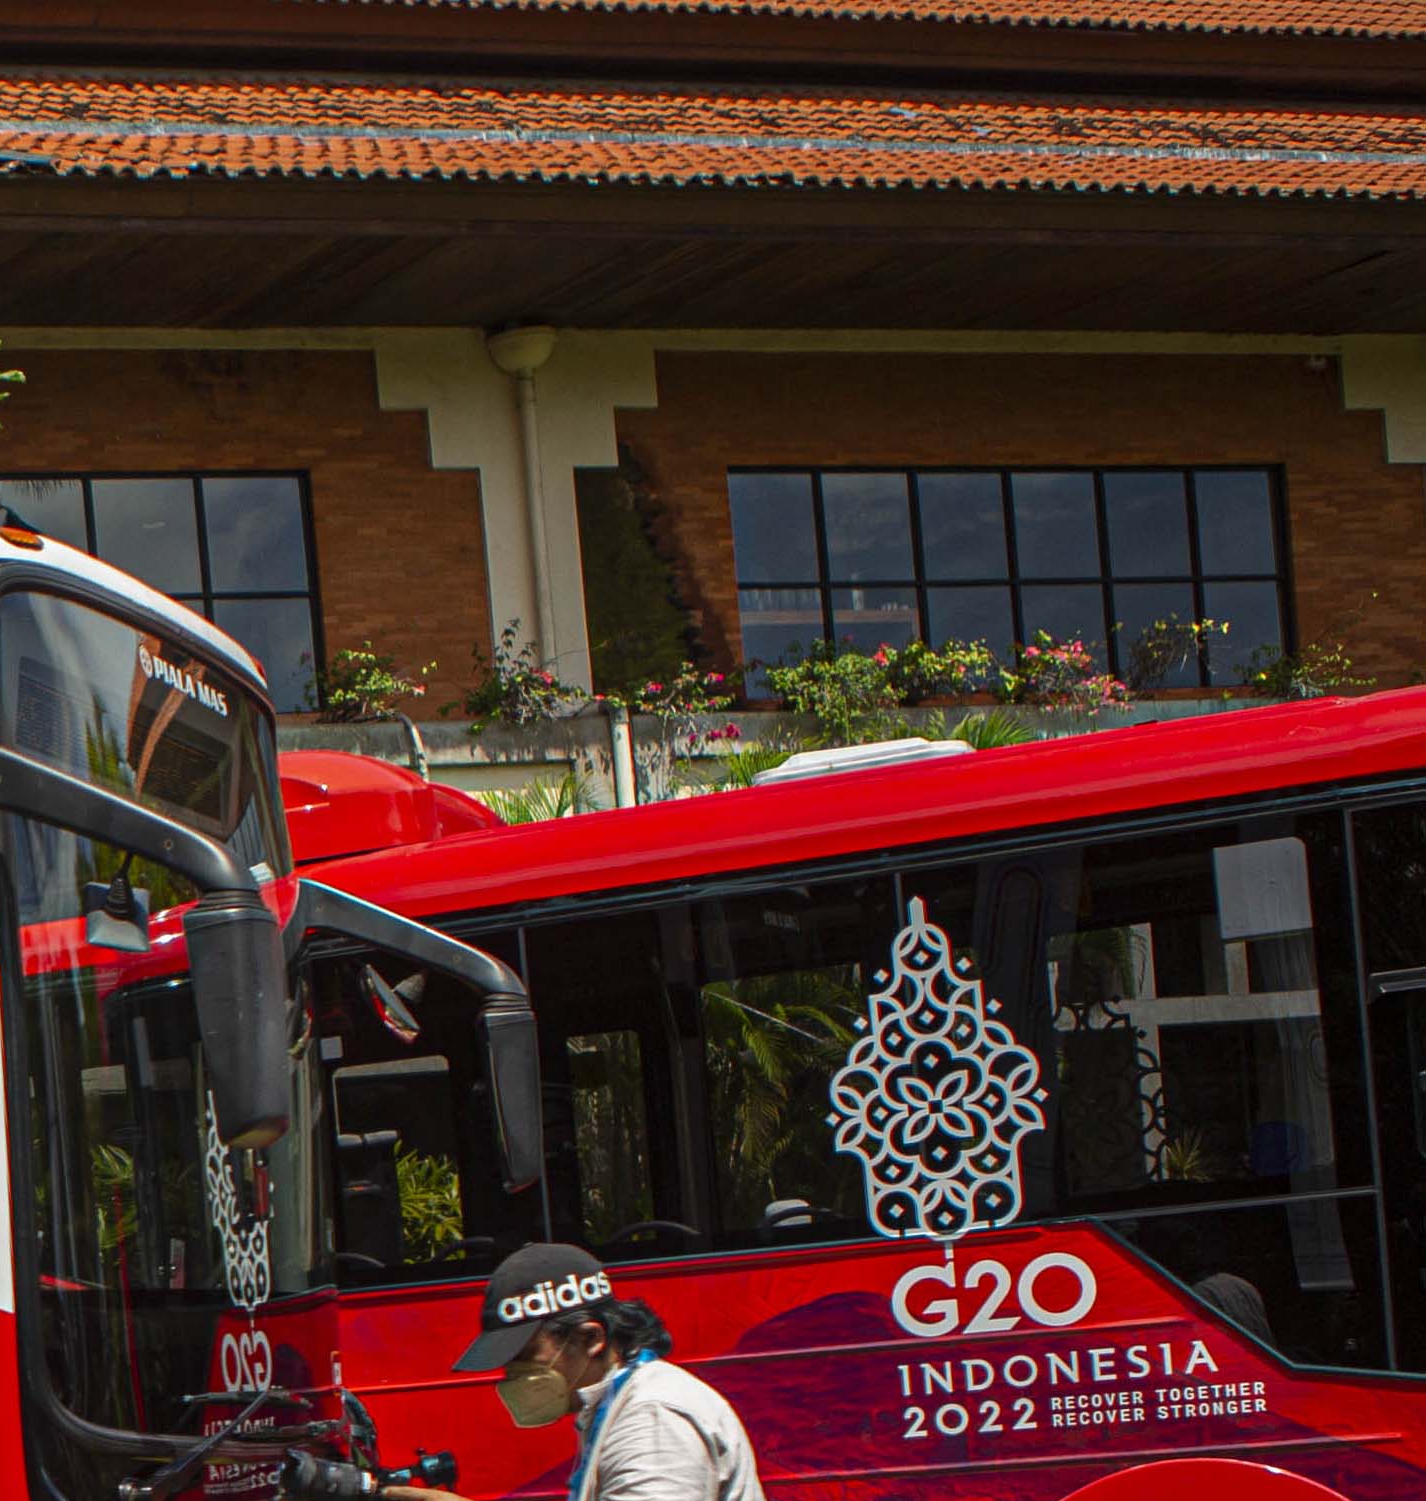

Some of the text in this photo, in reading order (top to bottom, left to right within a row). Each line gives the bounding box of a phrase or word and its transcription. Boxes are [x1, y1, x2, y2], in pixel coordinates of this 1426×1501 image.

[153, 655, 228, 717] PIALA MAS
[498, 1271, 613, 1323] adidas
[891, 1252, 1097, 1338] G20
[897, 1340, 1219, 1396] INDONESIA
[903, 1398, 1038, 1439] 2022
[1051, 1381, 1266, 1411] RECOVER TOGETHER
[1052, 1398, 1268, 1428] RECOVER STRONGER
